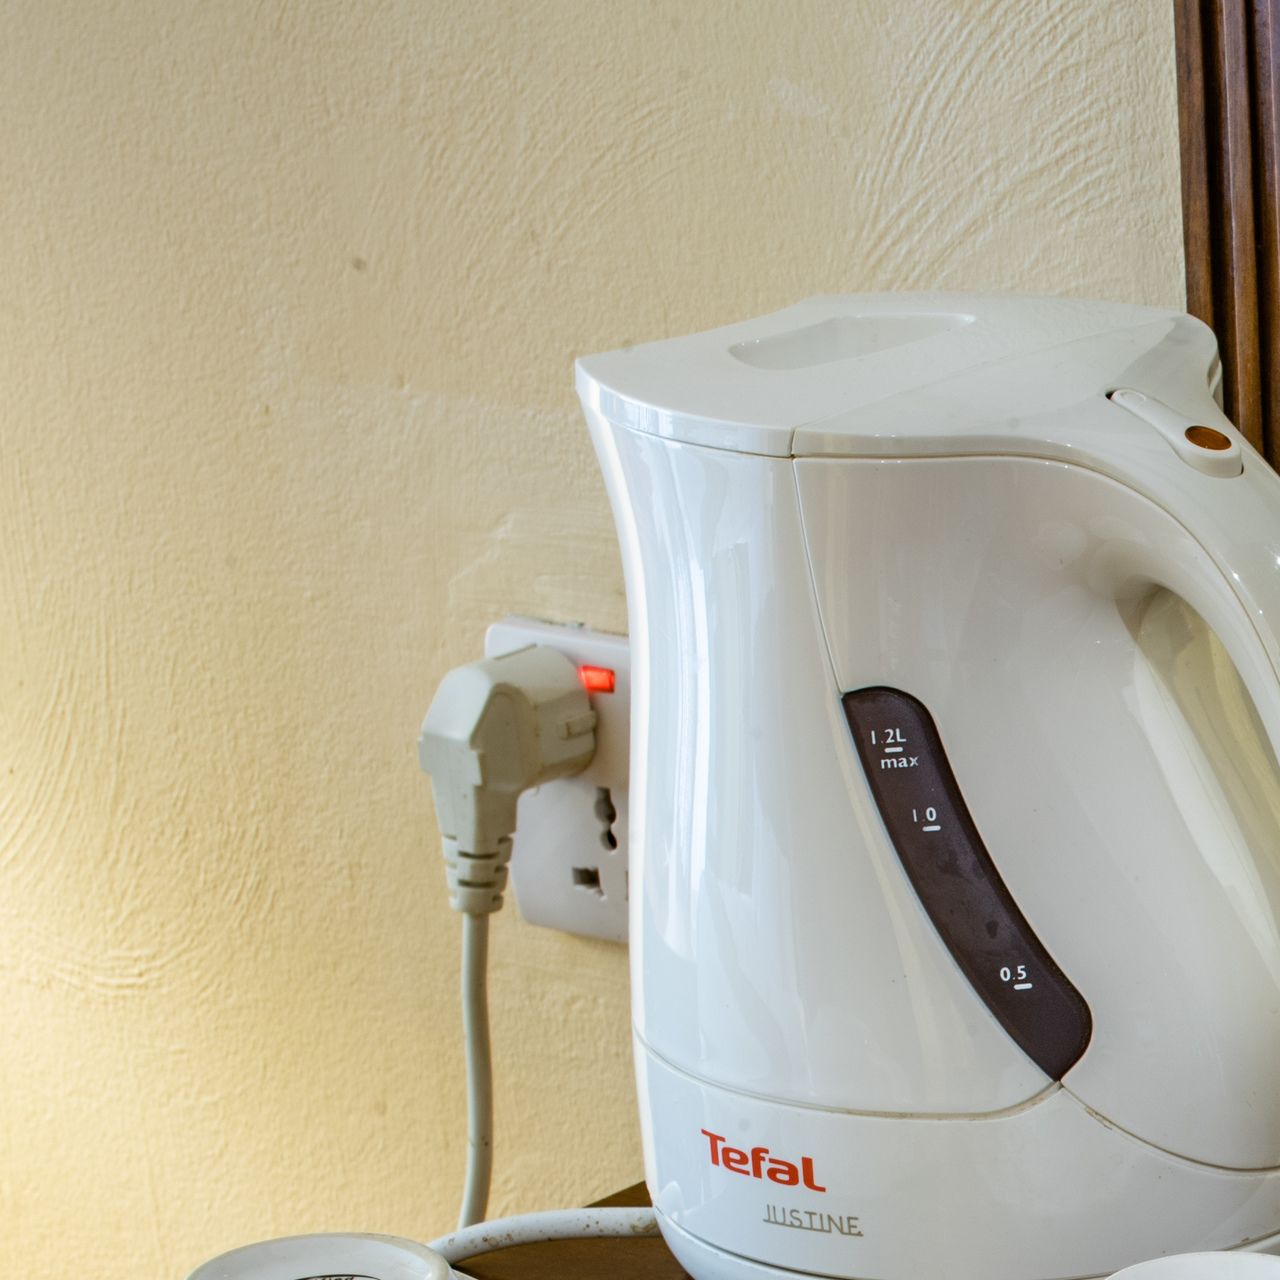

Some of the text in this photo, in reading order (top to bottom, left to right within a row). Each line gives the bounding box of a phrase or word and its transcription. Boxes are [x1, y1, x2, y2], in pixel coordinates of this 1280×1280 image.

[880, 755, 919, 769] max
[999, 965, 1027, 982] 0.5
[701, 1128, 827, 1192] Tefal
